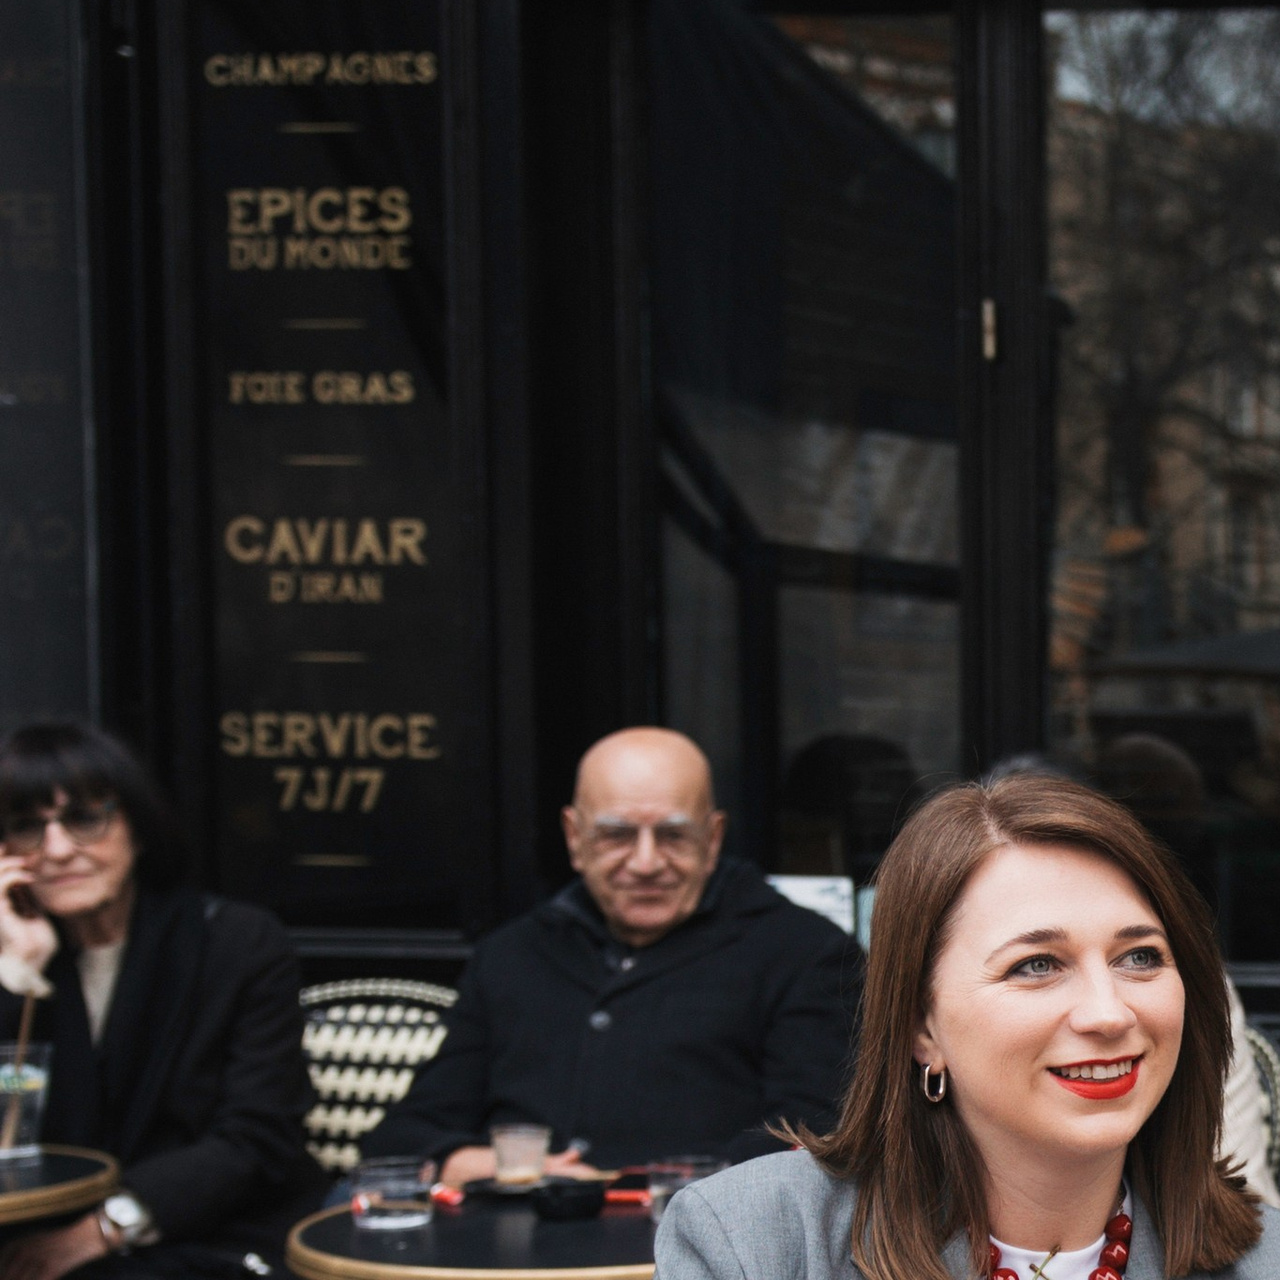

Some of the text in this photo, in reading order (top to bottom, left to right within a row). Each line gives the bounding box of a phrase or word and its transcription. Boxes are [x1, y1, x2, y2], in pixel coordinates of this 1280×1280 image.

[208, 52, 436, 85] CHAMPAGNES
[227, 187, 412, 235] EPICES
[228, 235, 412, 270] DU MONDE
[229, 371, 415, 404] FOIE GRAS
[225, 516, 426, 564] CAVIAR
[220, 713, 438, 759] SERVICE
[275, 768, 384, 810] 7J/7
